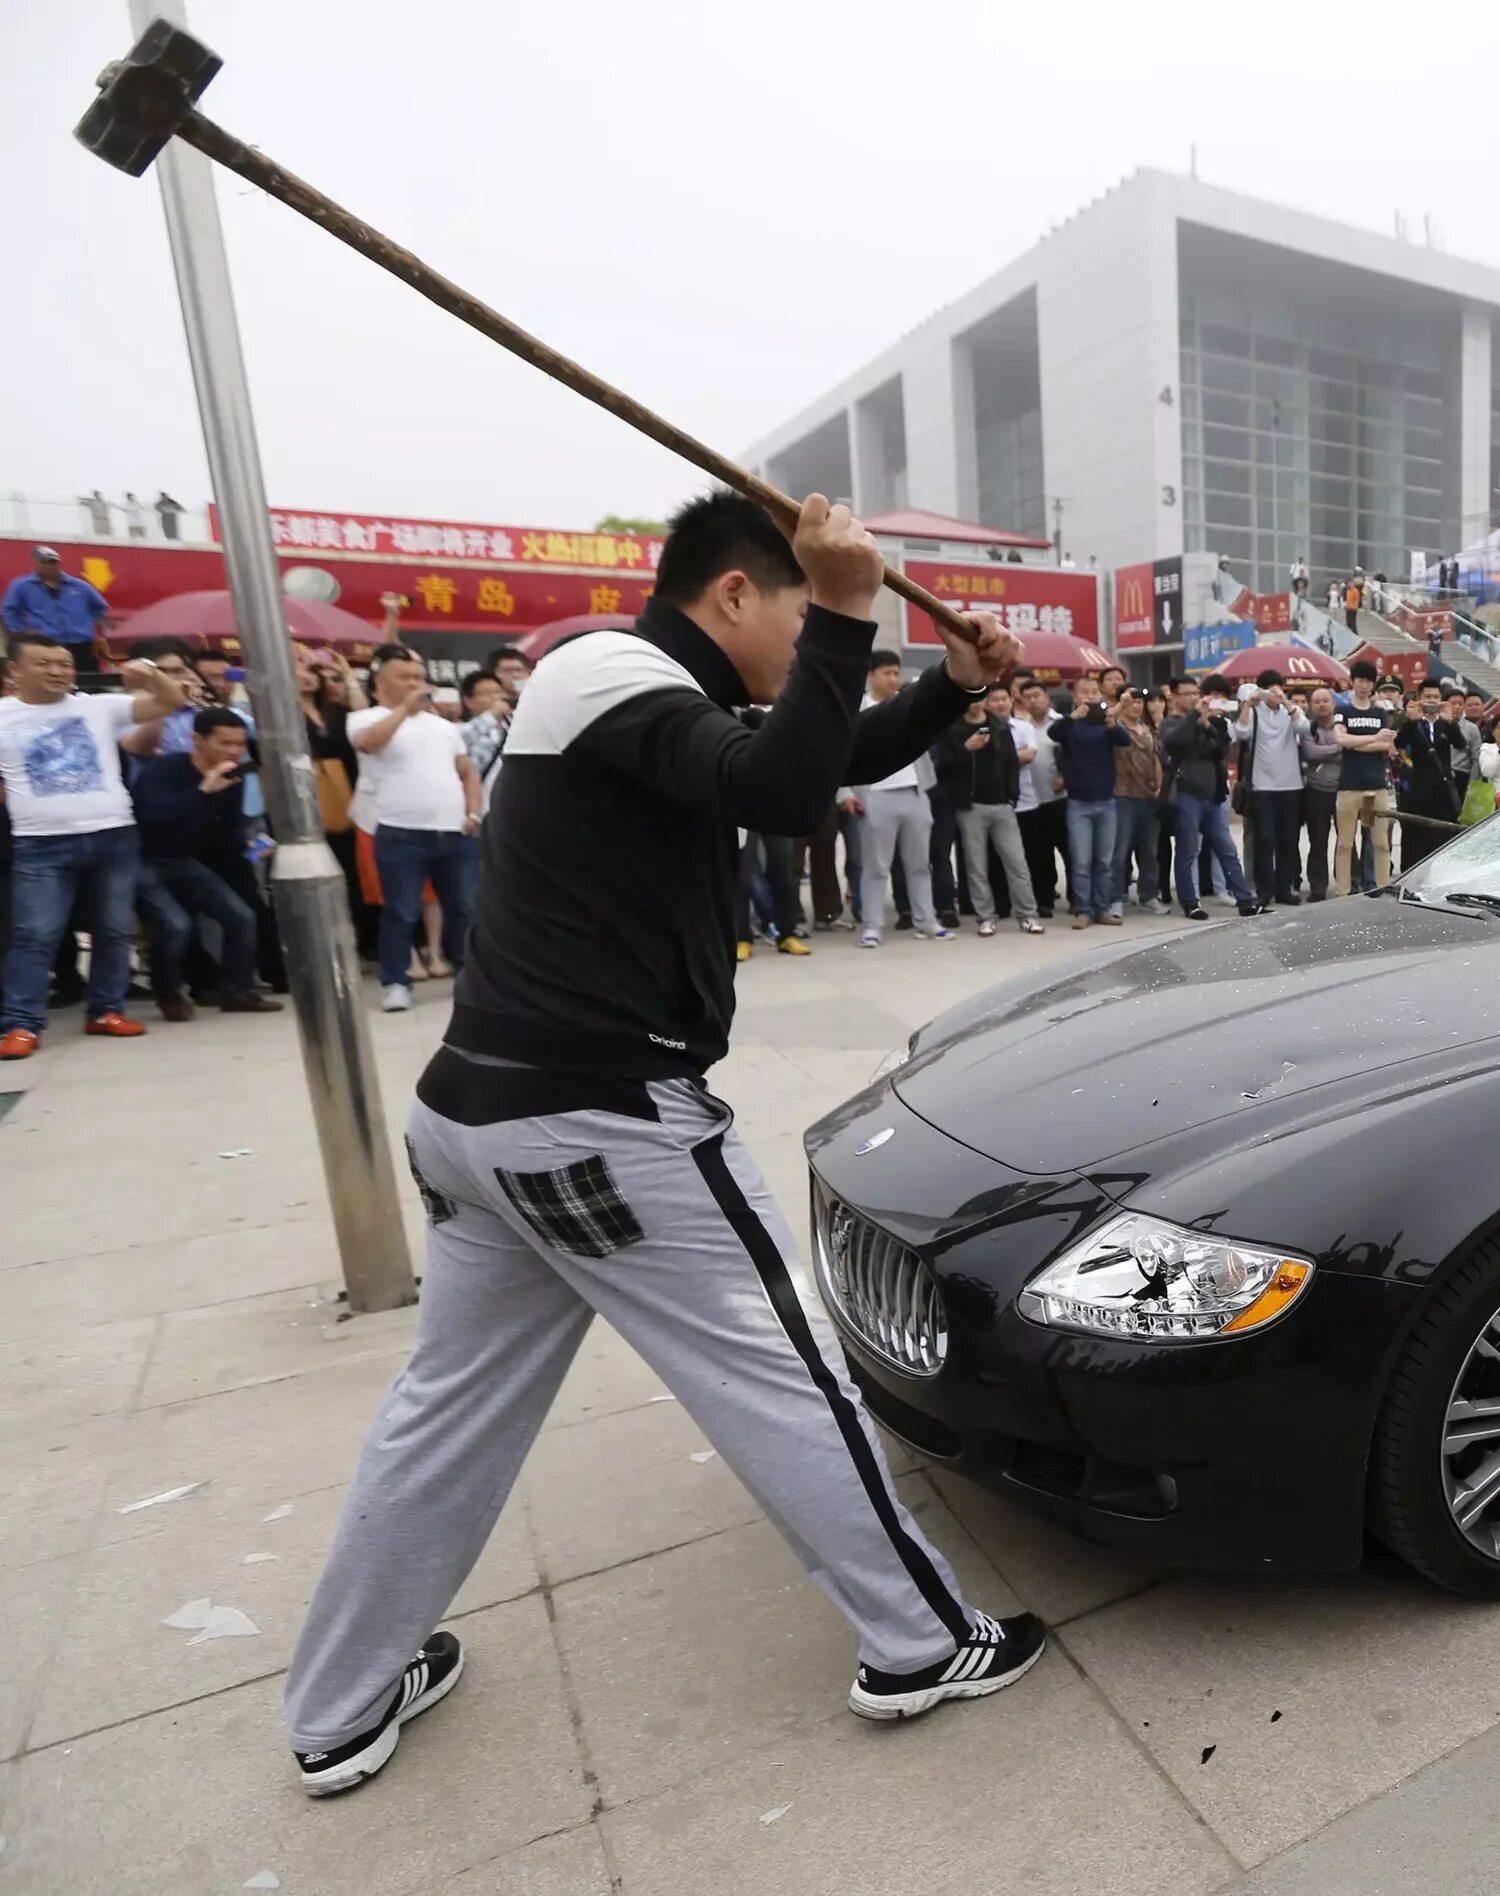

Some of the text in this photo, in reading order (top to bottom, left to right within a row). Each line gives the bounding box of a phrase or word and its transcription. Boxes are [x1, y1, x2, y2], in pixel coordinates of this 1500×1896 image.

[1159, 384, 1174, 406] 4
[1161, 485, 1176, 506] 3
[933, 573, 1006, 596] 大型超市
[1154, 572, 1180, 596] 麦当劳
